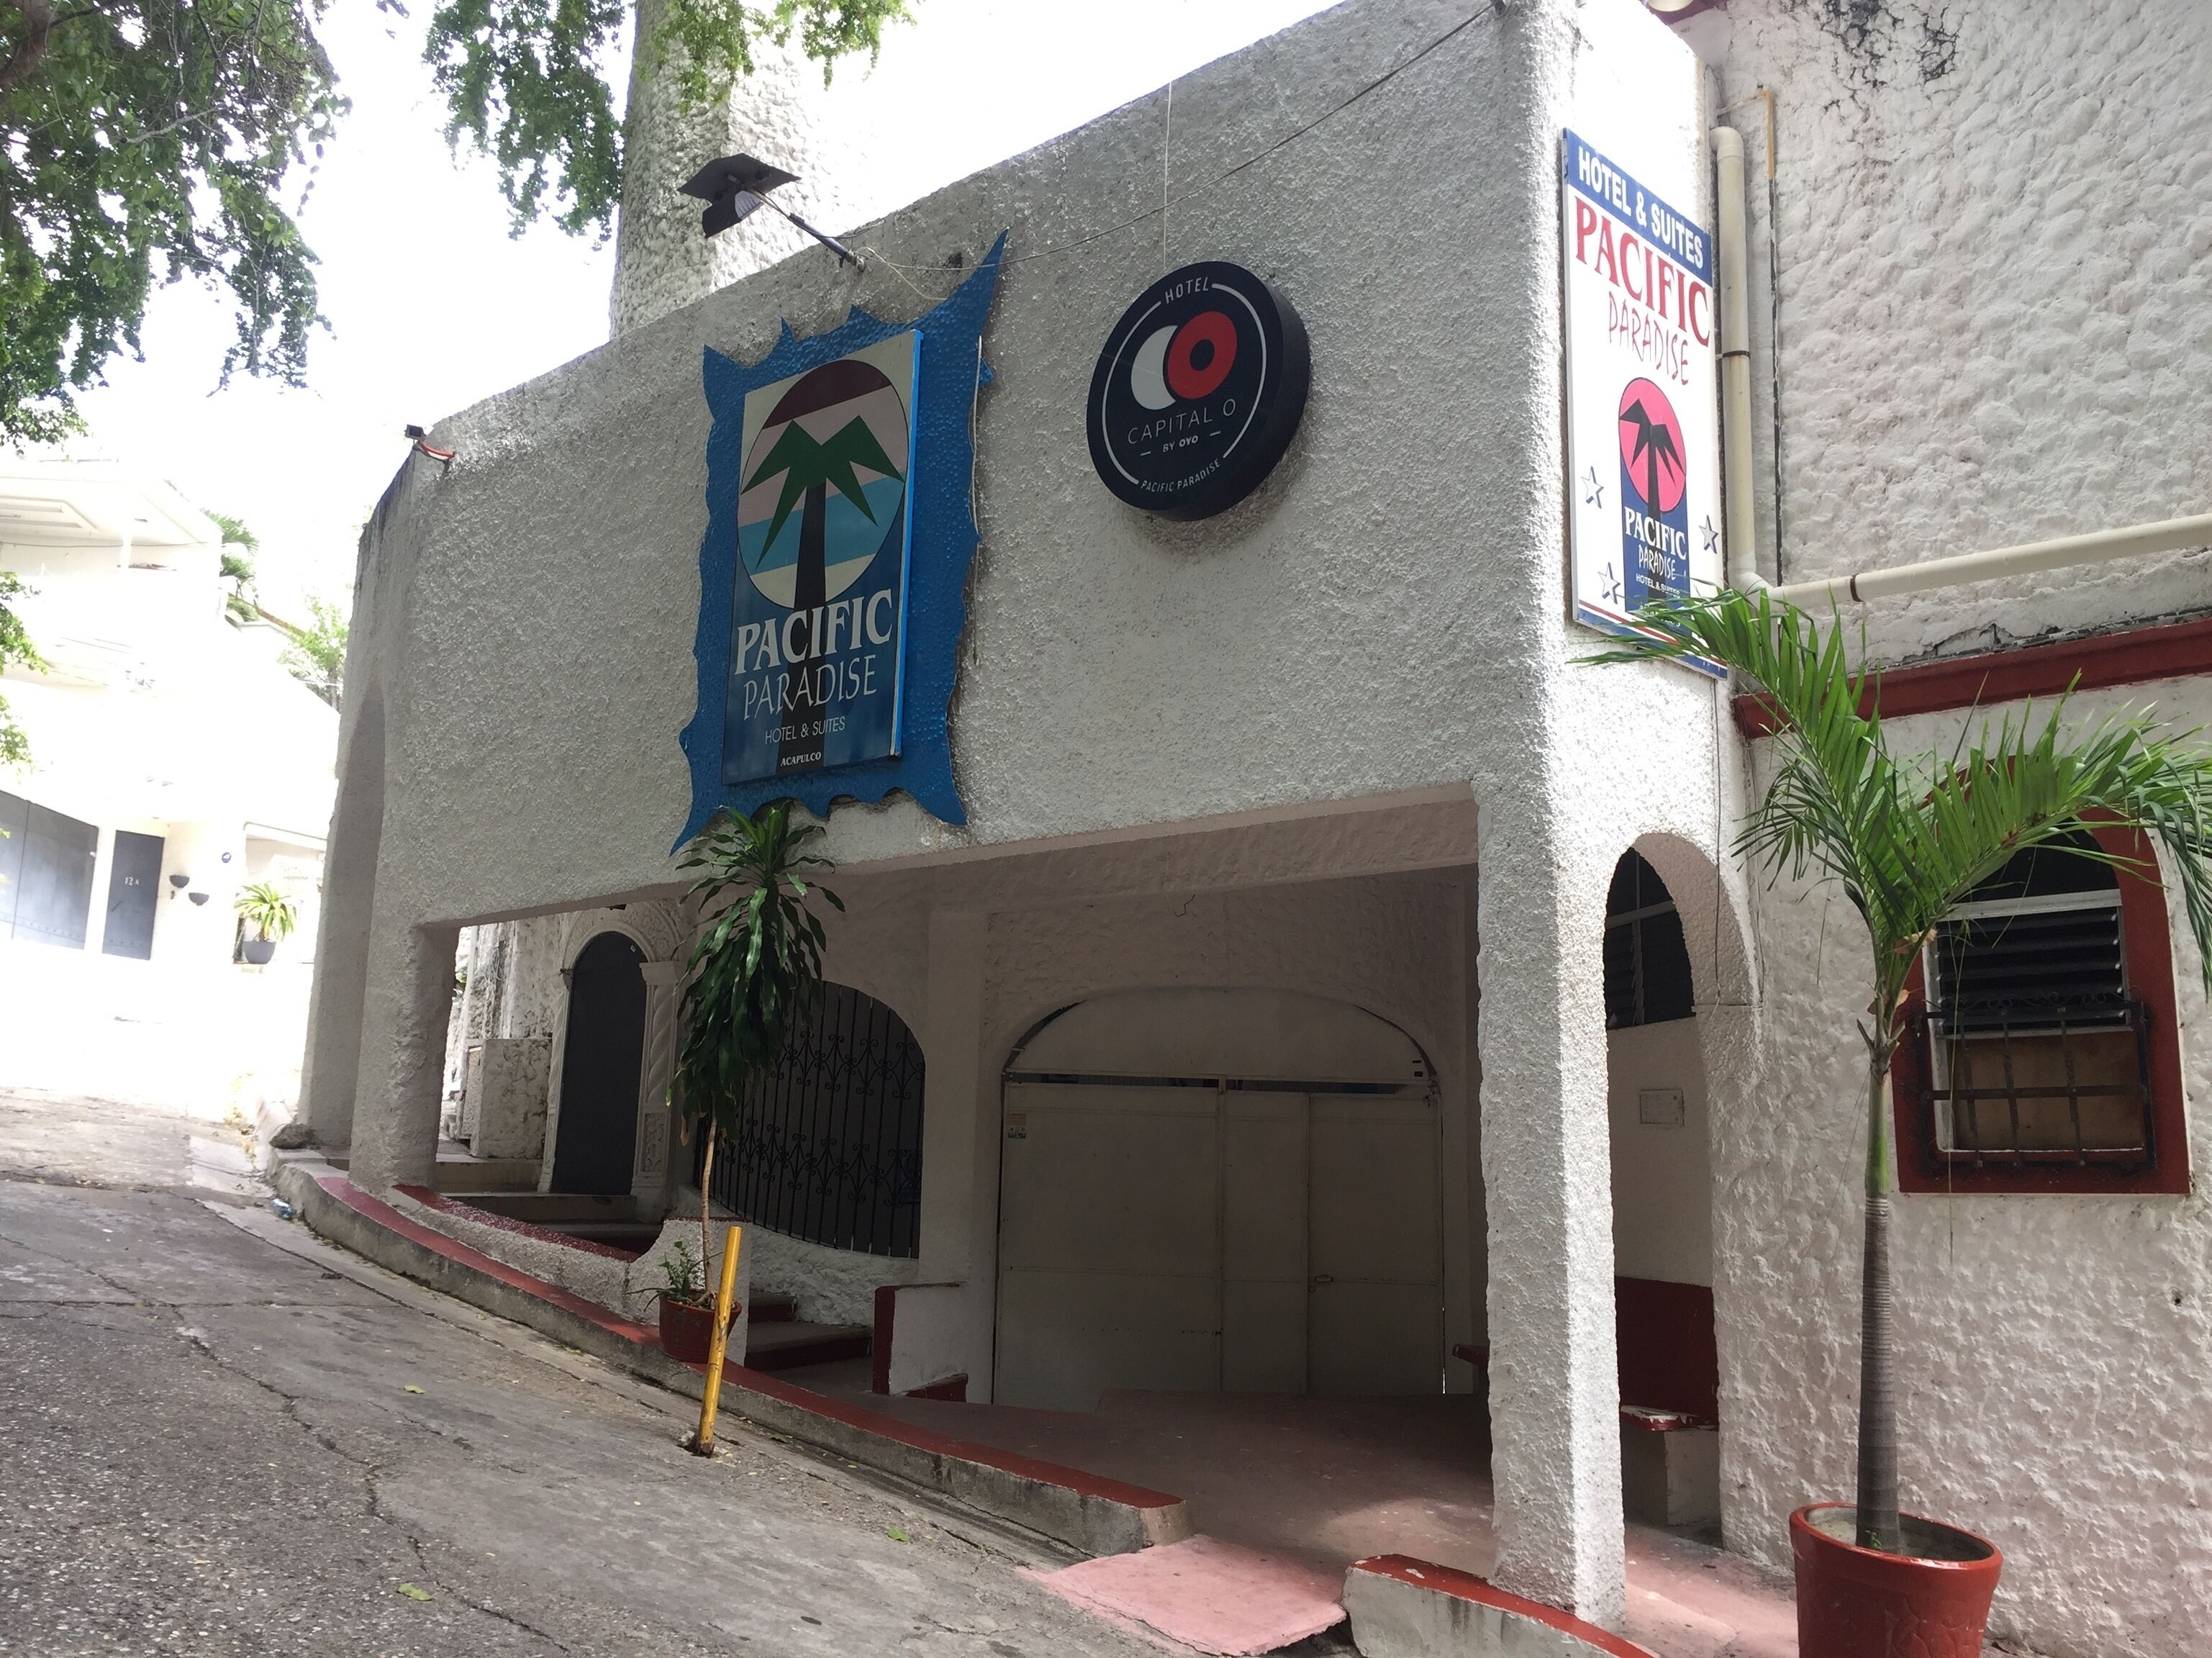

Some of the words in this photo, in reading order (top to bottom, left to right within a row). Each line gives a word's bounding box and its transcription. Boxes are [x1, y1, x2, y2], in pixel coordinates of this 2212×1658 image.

[1578, 145, 1631, 217] HOTEL
[1636, 191, 1647, 228] &
[1651, 202, 1703, 269] SUITES
[1165, 276, 1209, 304] HOTEL
[1574, 195, 1710, 348] PACIFIC
[1608, 291, 1689, 386] PARADISE
[1128, 407, 1213, 445] CAPITAL
[1223, 398, 1236, 417] O
[1162, 441, 1175, 453] BY
[1179, 435, 1199, 448] OYO
[1141, 480, 1174, 493] PACIFIC
[1177, 458, 1221, 490] PARADISE
[1624, 506, 1687, 561] PACIFIC
[1636, 573, 1656, 589] HOTEL
[1656, 581, 1661, 590] &
[1638, 544, 1677, 581] PARADISE
[734, 588, 892, 675] PACIFIC
[743, 654, 877, 721] PARADISE
[765, 725, 797, 744] HOTEL
[801, 723, 810, 738] &
[812, 716, 846, 735] SUITES
[780, 751, 822, 766] ACAPULCO
